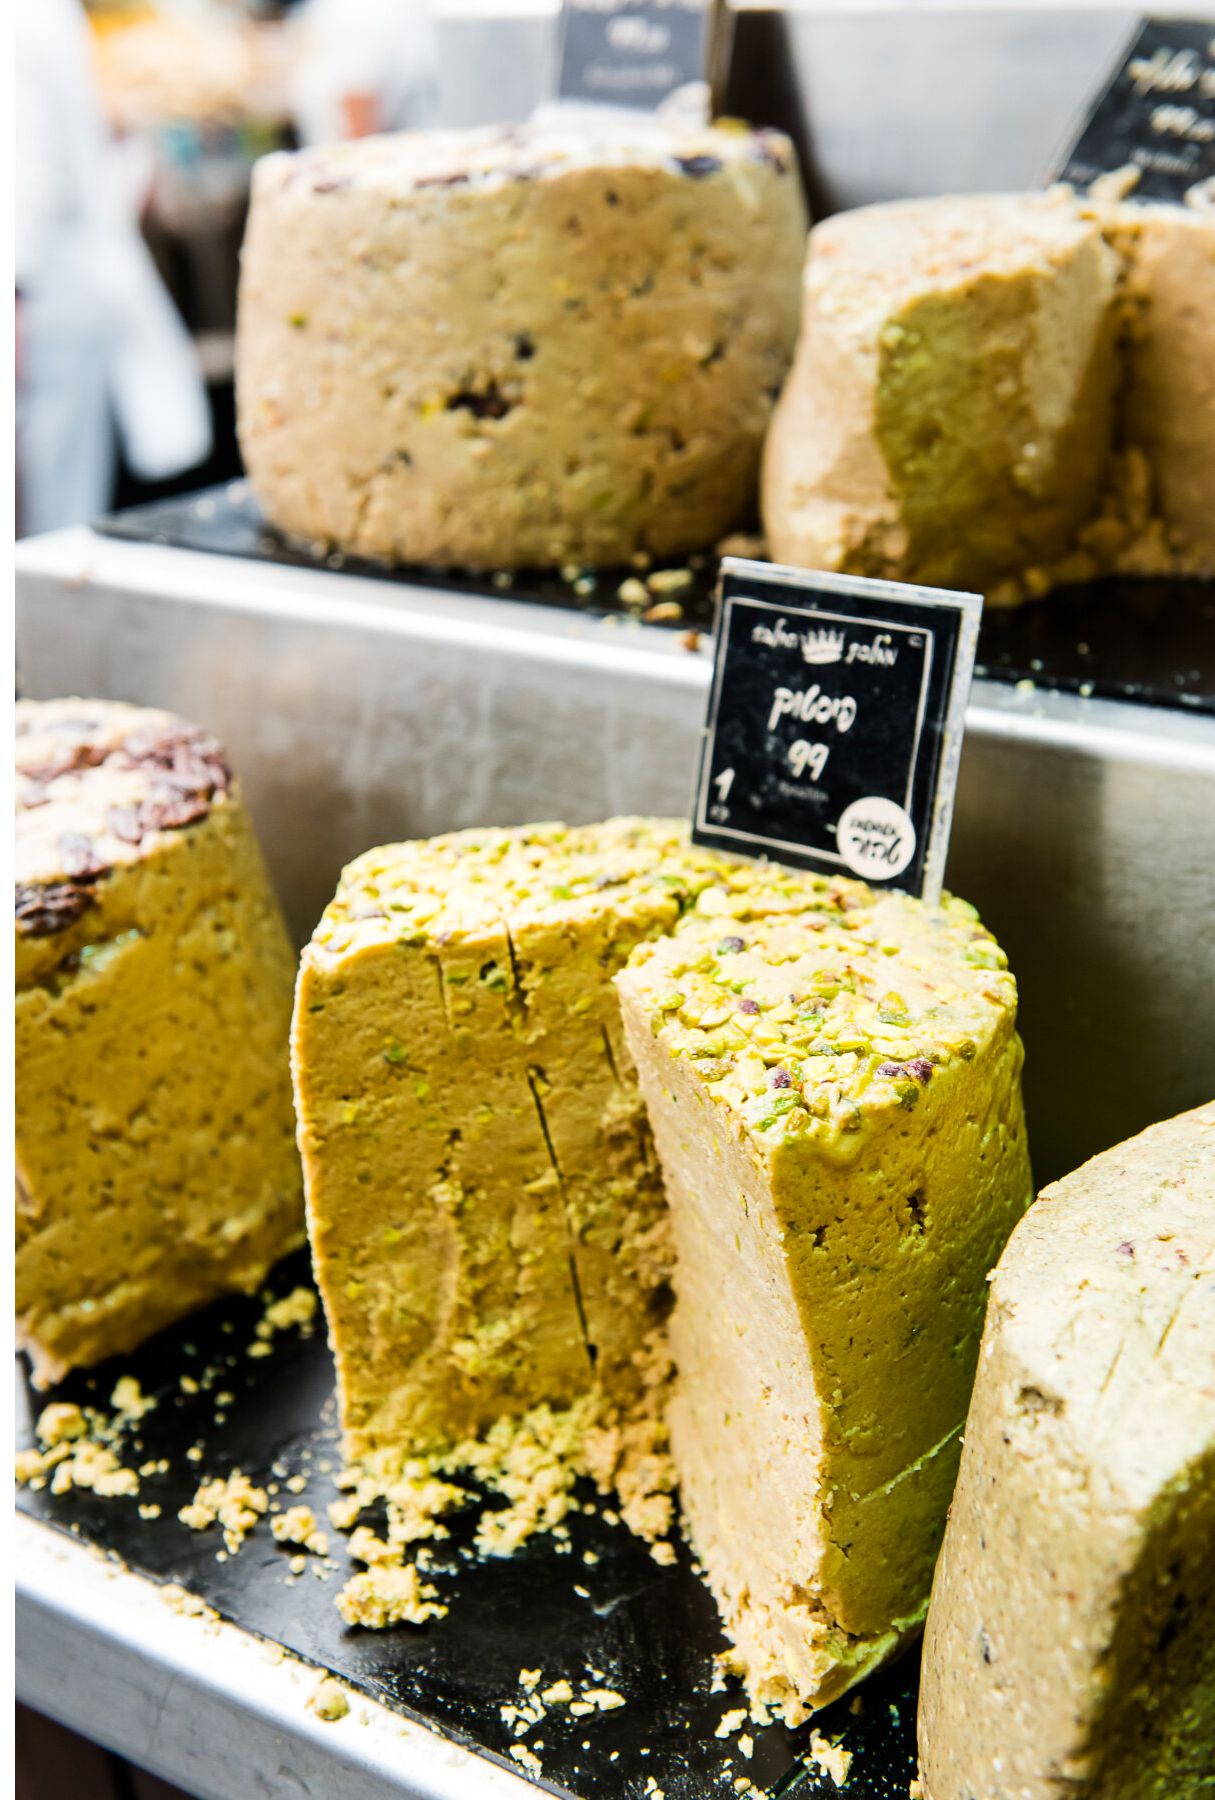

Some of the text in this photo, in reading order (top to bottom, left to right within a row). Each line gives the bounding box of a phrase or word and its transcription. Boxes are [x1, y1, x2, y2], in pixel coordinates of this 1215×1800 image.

[767, 683, 858, 734] פיסטוק
[788, 739, 830, 780] 99
[714, 767, 736, 801] 1
